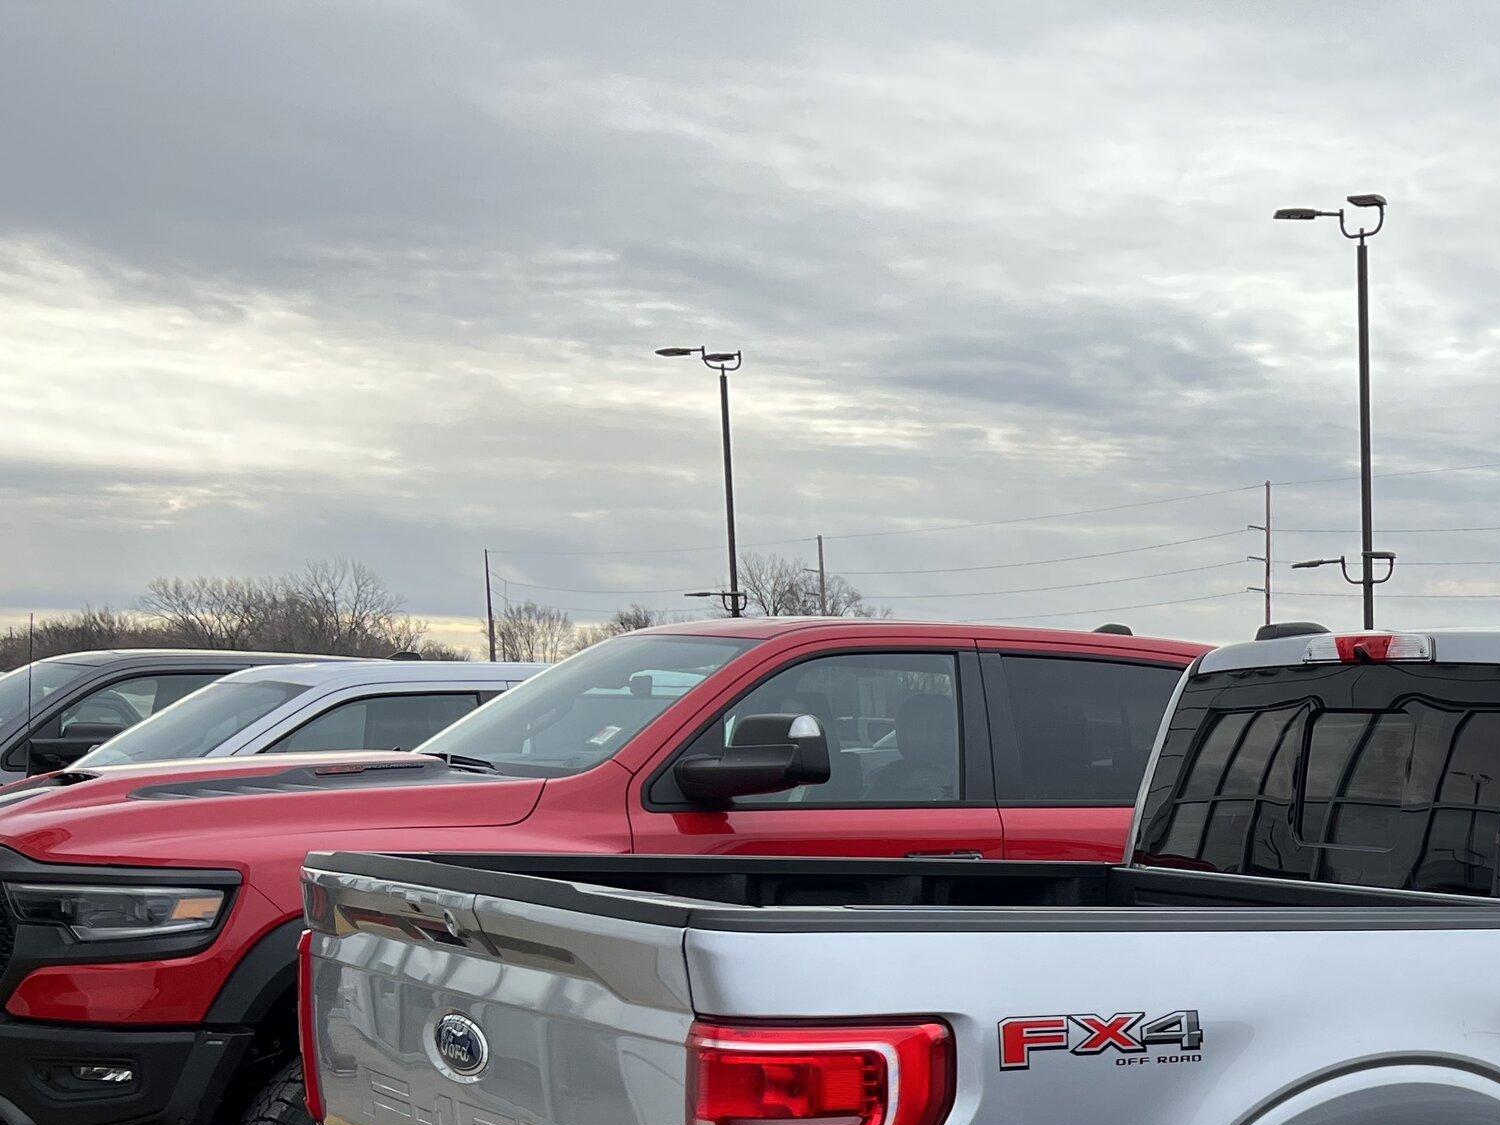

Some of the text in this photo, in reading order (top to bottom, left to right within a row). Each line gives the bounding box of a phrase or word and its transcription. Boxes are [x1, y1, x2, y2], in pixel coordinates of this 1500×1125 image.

[440, 1026, 470, 1062] Ford
[998, 1009, 1204, 1072] FX4
[1115, 1054, 1202, 1066] OFF ROAD
